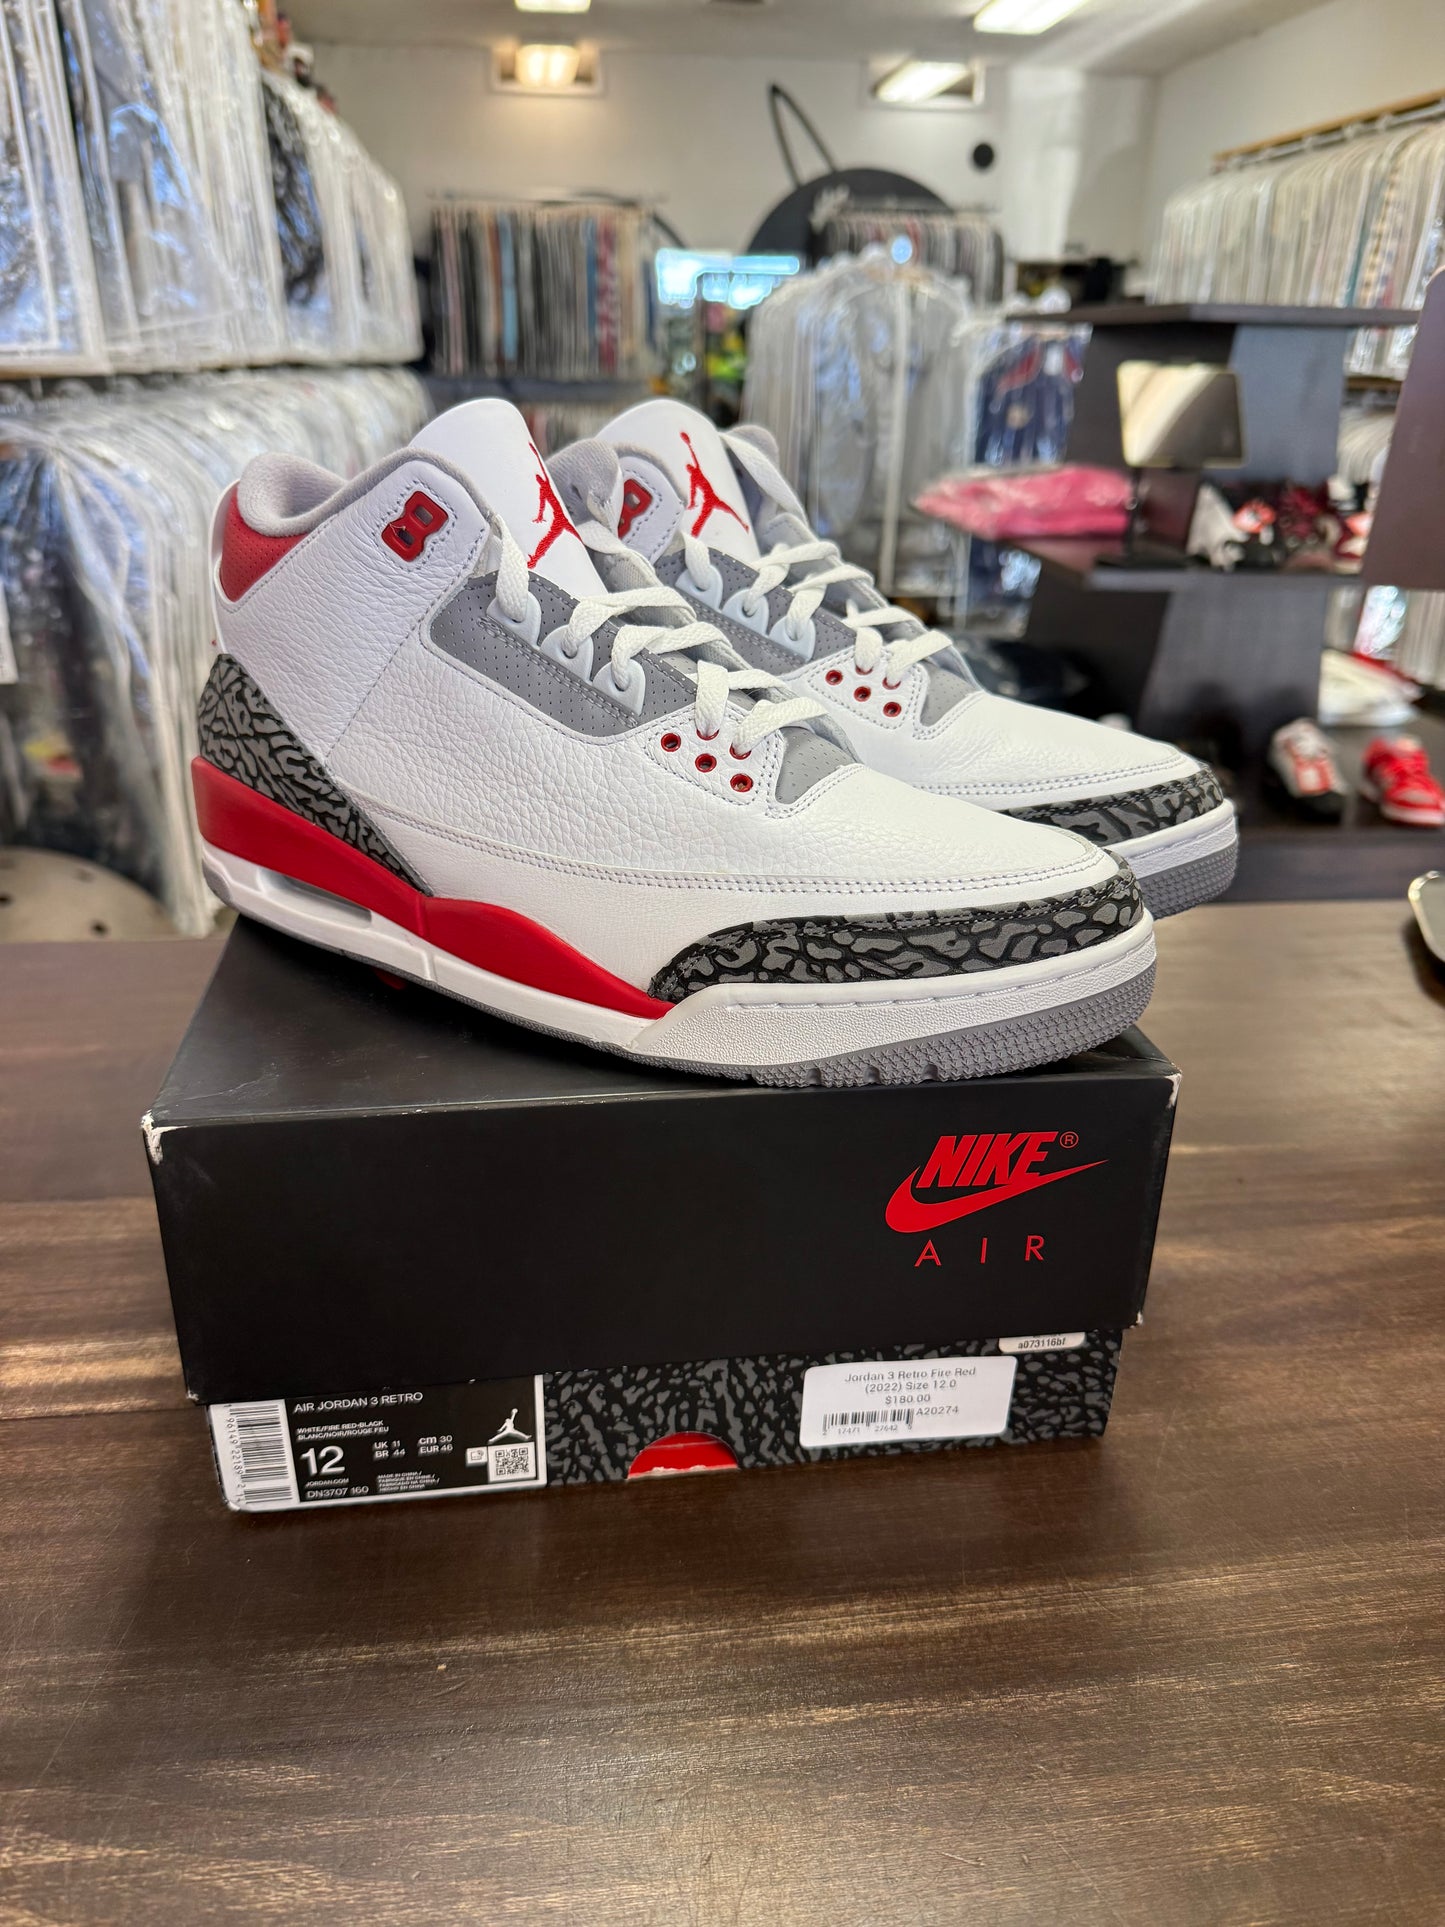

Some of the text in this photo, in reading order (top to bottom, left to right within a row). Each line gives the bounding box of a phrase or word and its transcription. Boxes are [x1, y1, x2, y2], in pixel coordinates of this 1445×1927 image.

[914, 1235, 1045, 1267] AIR
[844, 1367, 977, 1383] Jordan 3 Retro Fire Red
[865, 1379, 957, 1394] (2022) Size 12.0
[293, 1391, 424, 1413] AIR JORDAN 3 RETRO
[885, 1394, 931, 1405] $180.00
[916, 1405, 959, 1416] A20274
[297, 1420, 384, 1435] WHITE/FIRE RED-BLACK
[298, 1426, 390, 1441] BLANC/NOIR/ROUGE FEU
[374, 1440, 401, 1450] UK 11
[419, 1434, 453, 1446] cm 30
[375, 1448, 406, 1459] BR 44
[420, 1443, 454, 1454] EUR 46
[301, 1445, 346, 1476] 12
[305, 1478, 349, 1487] JORDAN.COM
[307, 1485, 369, 1498] DN3707 160
